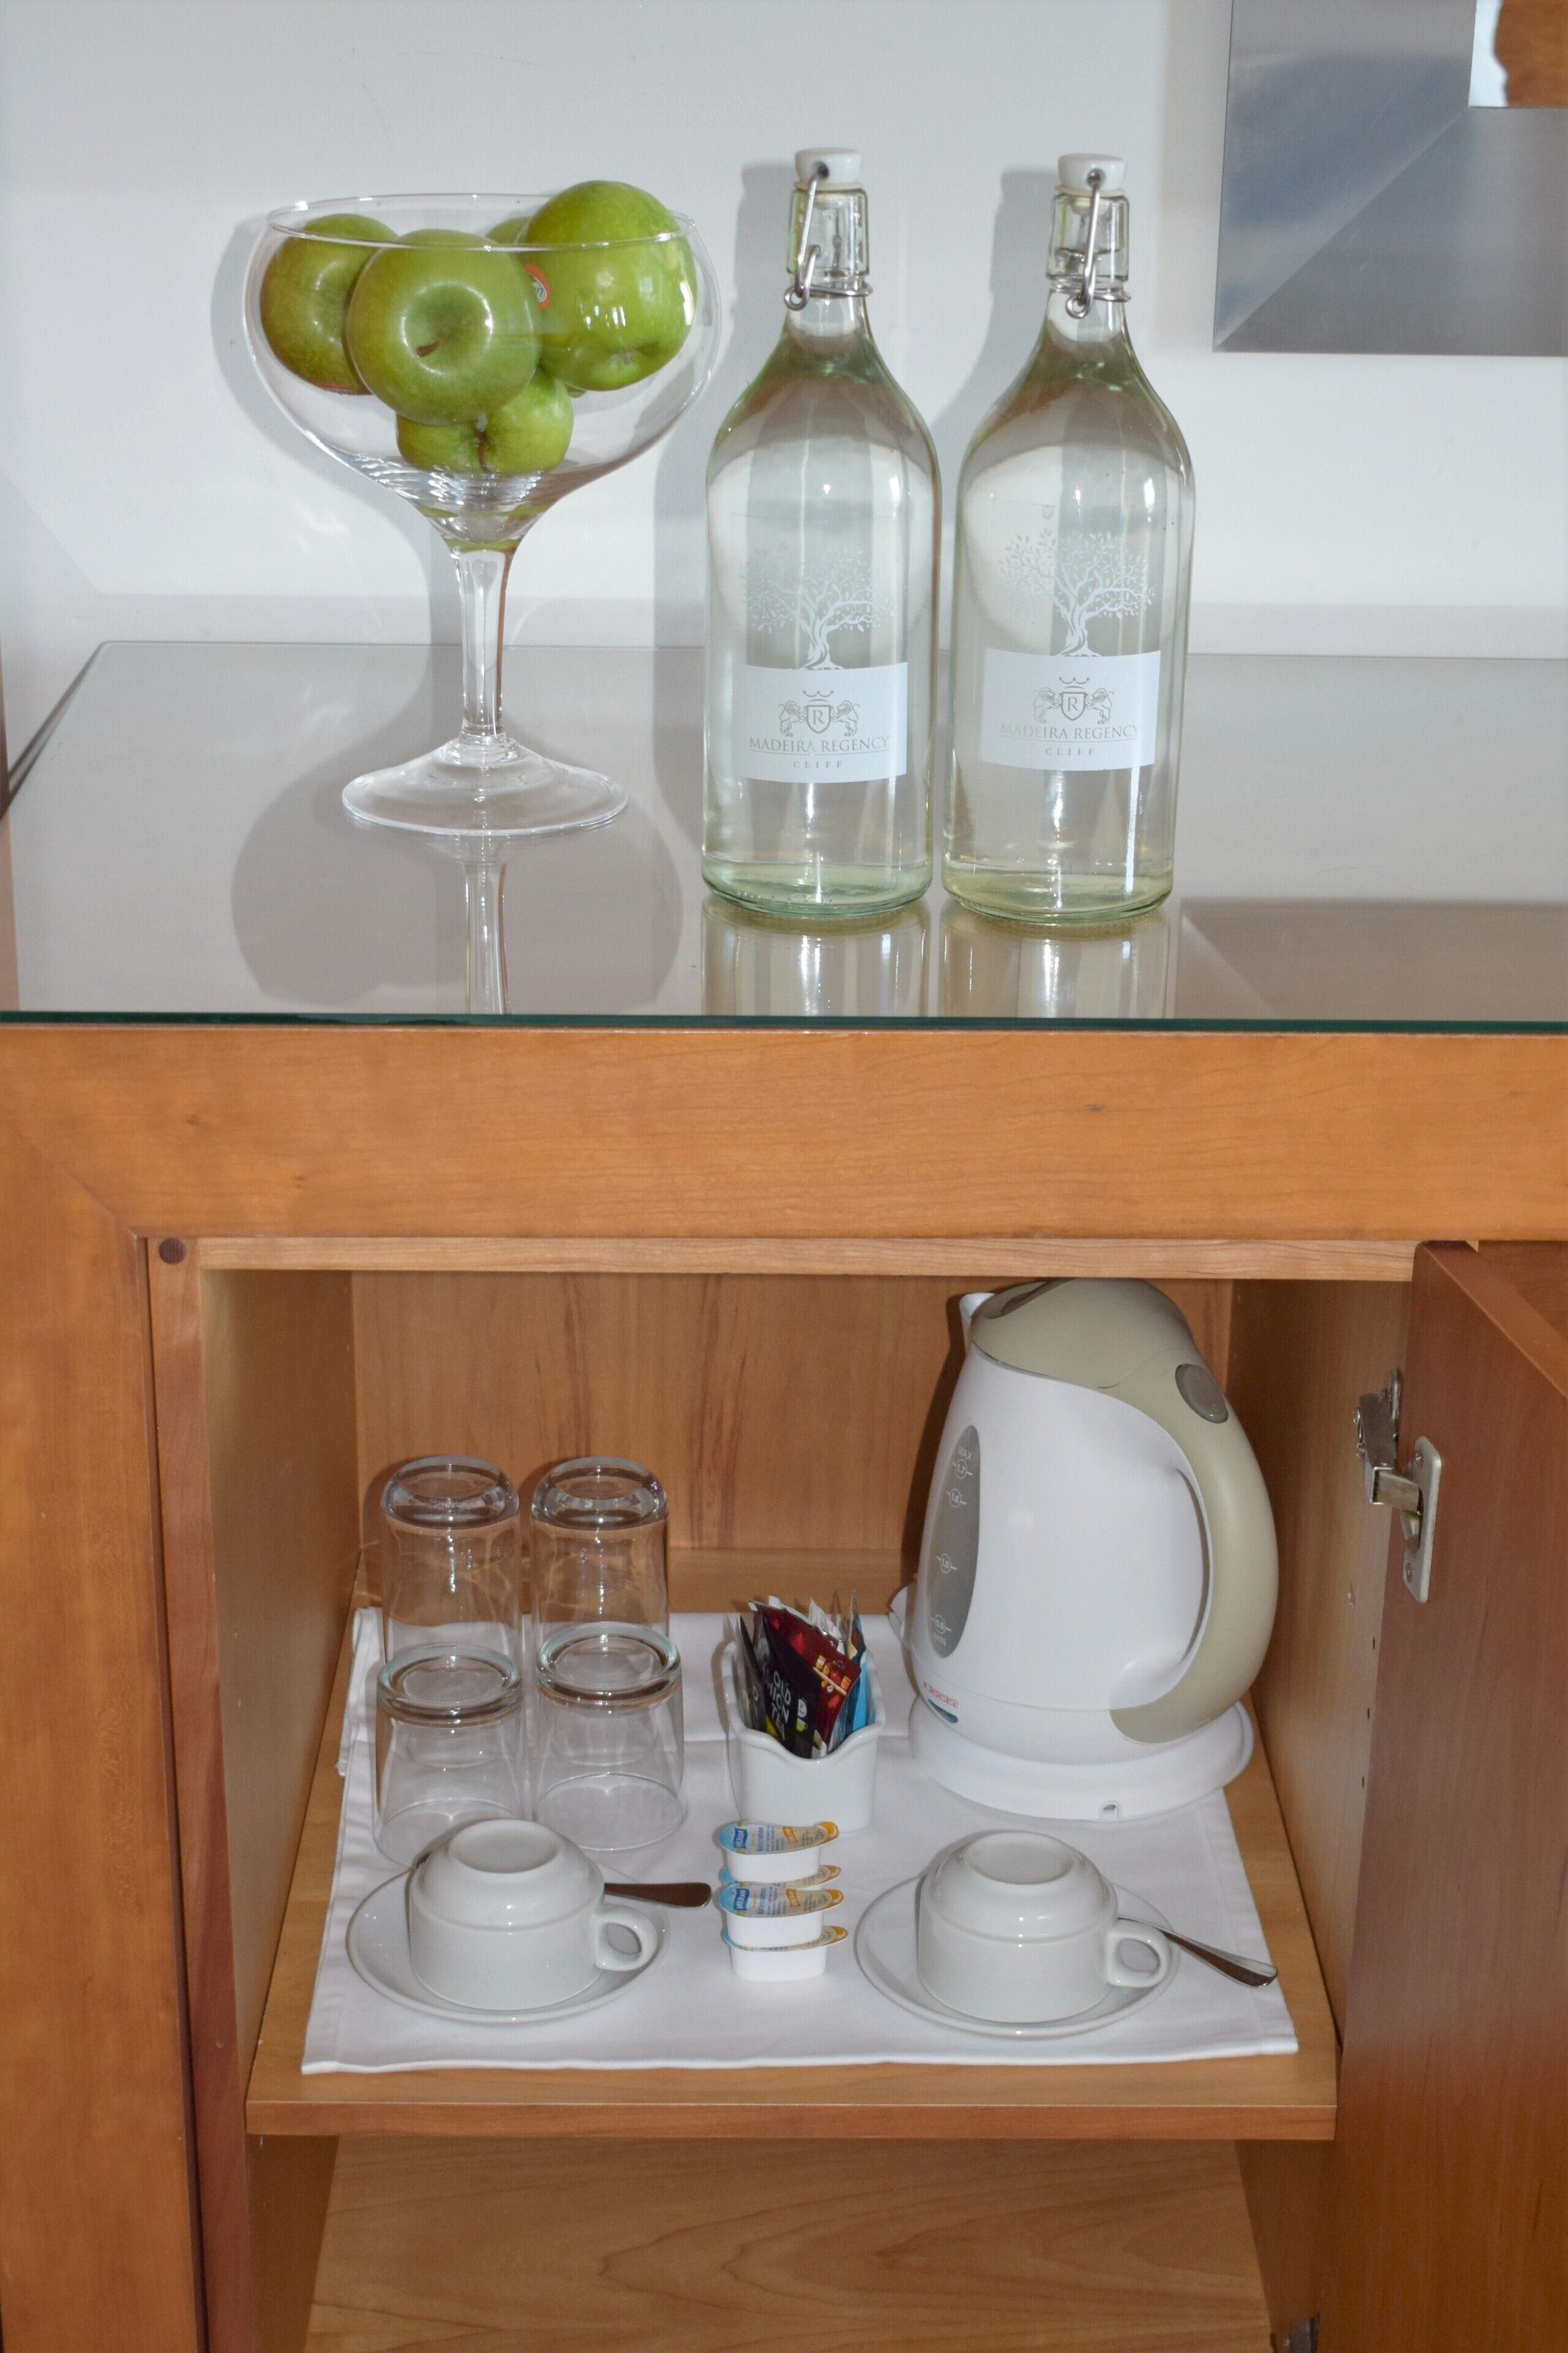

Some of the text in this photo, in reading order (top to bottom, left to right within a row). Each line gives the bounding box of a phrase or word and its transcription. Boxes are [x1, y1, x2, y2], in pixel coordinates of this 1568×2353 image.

[1067, 696, 1079, 712] R
[812, 709, 825, 725] R
[1000, 724, 1139, 740] MADEIRA REGENCY
[749, 735, 889, 752] MADEIRA REGENCY
[1045, 748, 1094, 756] CLIFF
[793, 760, 843, 769] CLIFF
[957, 1445, 973, 1461] MAX
[957, 1464, 966, 1474] 1.7
